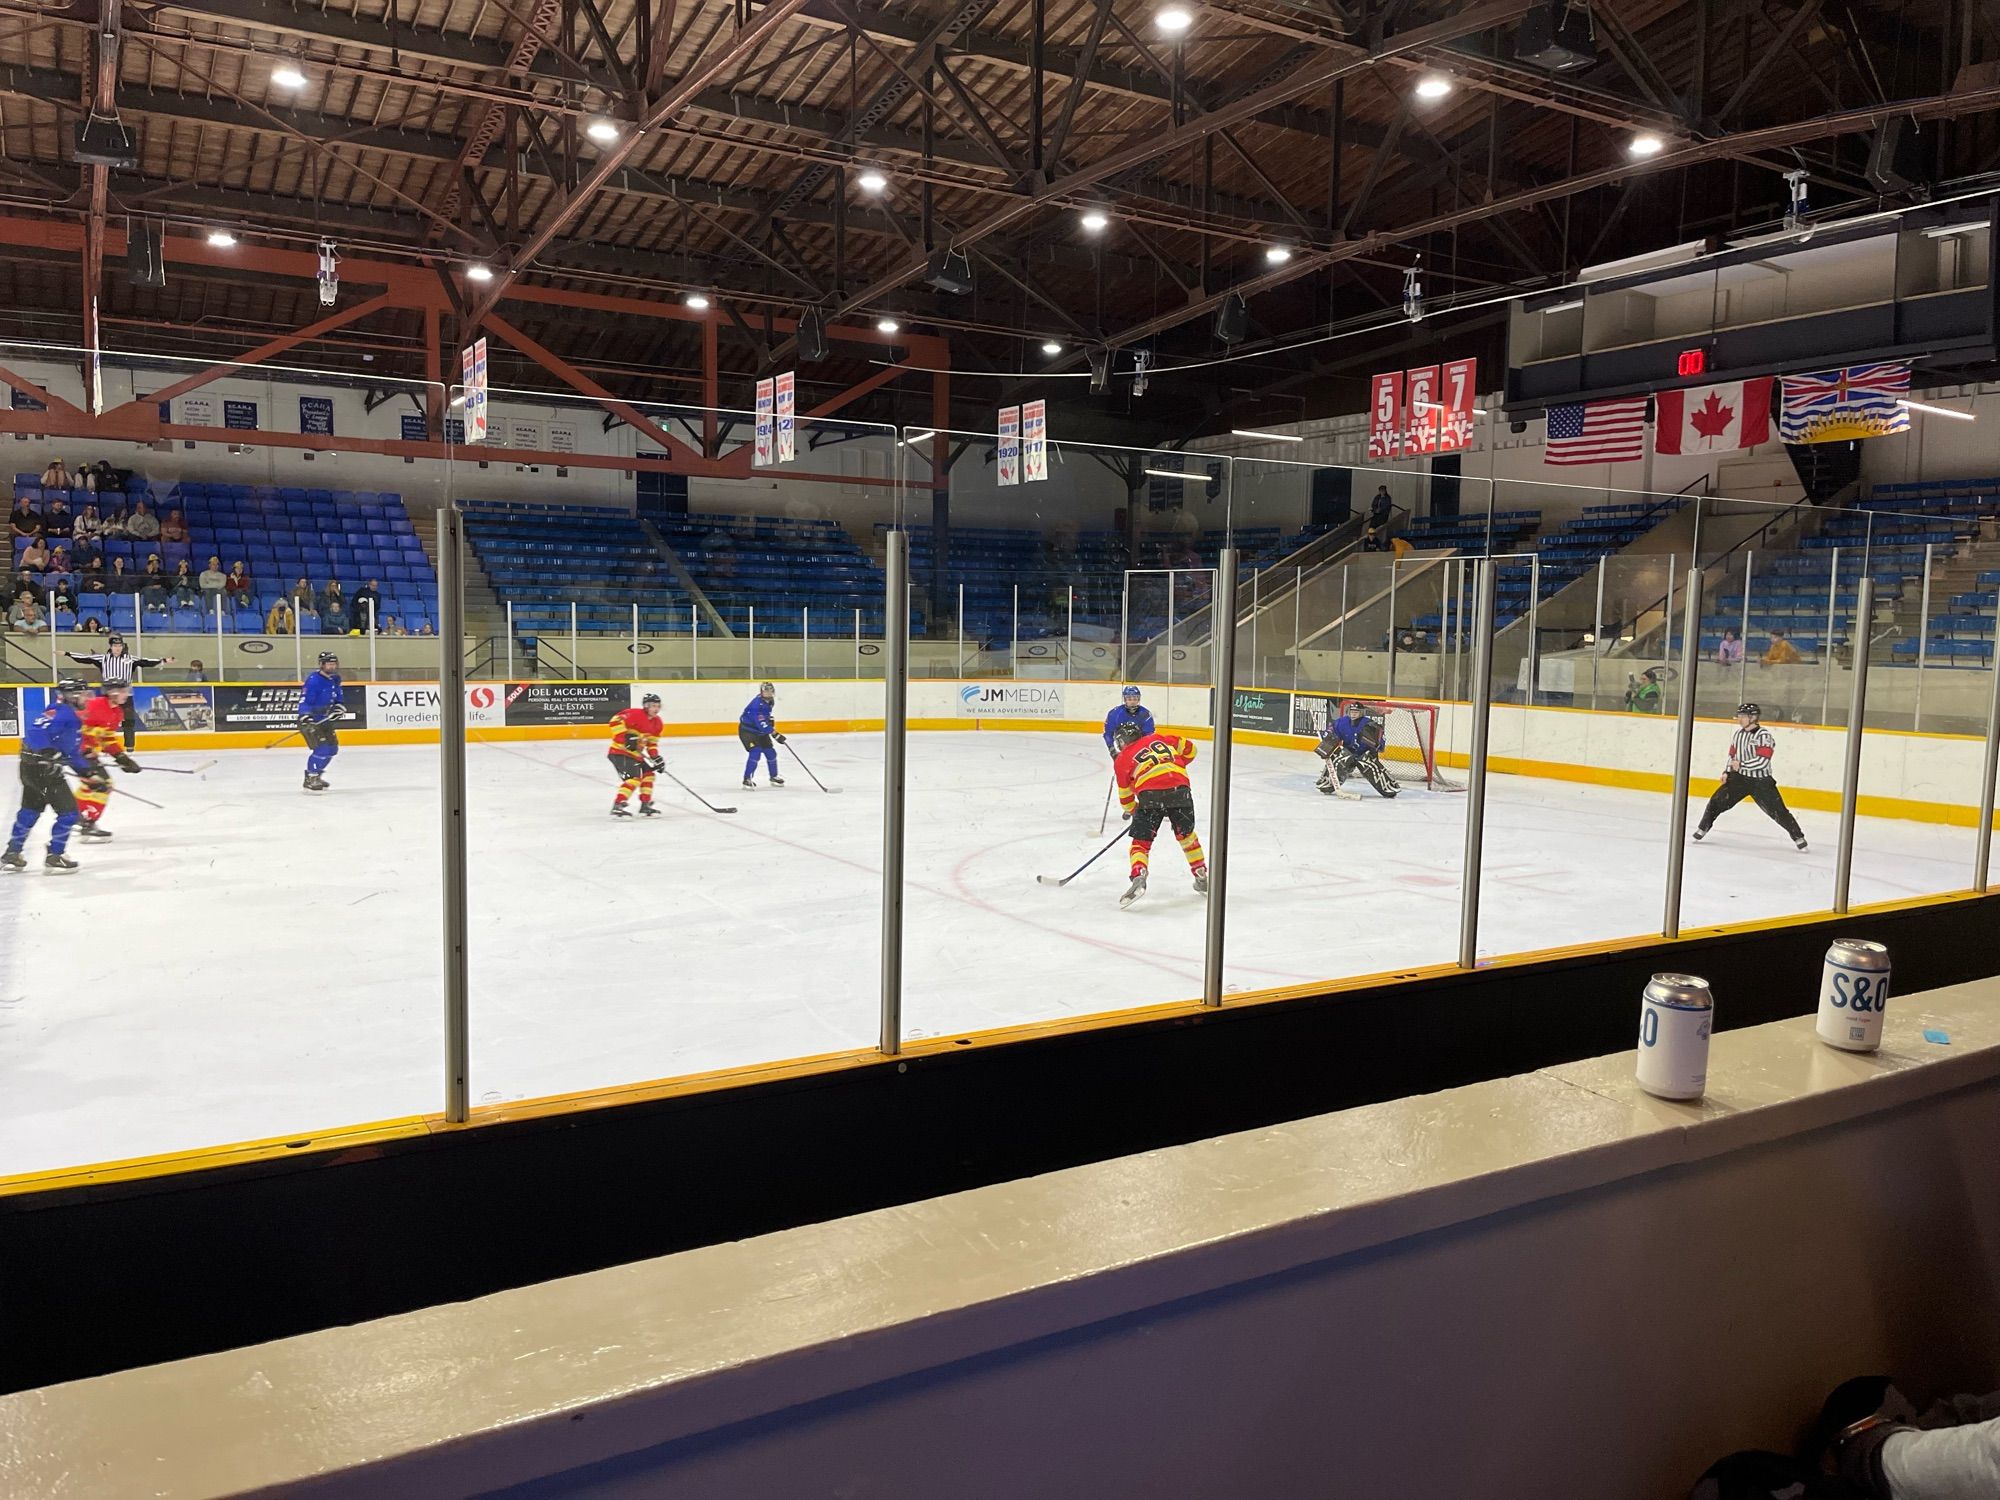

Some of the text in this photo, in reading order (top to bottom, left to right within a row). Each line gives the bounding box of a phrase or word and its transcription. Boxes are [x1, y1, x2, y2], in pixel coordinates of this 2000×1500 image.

[1378, 386, 1393, 422] 5
[1412, 380, 1430, 418] 6
[1451, 374, 1465, 411] 7
[998, 446, 1018, 458] 1920
[377, 691, 467, 707] SAFEW
[508, 686, 524, 703] SOLD
[528, 687, 609, 697] JOEL MCCREADY
[1133, 740, 1176, 765] 59
[1830, 972, 1888, 1012] S&O
